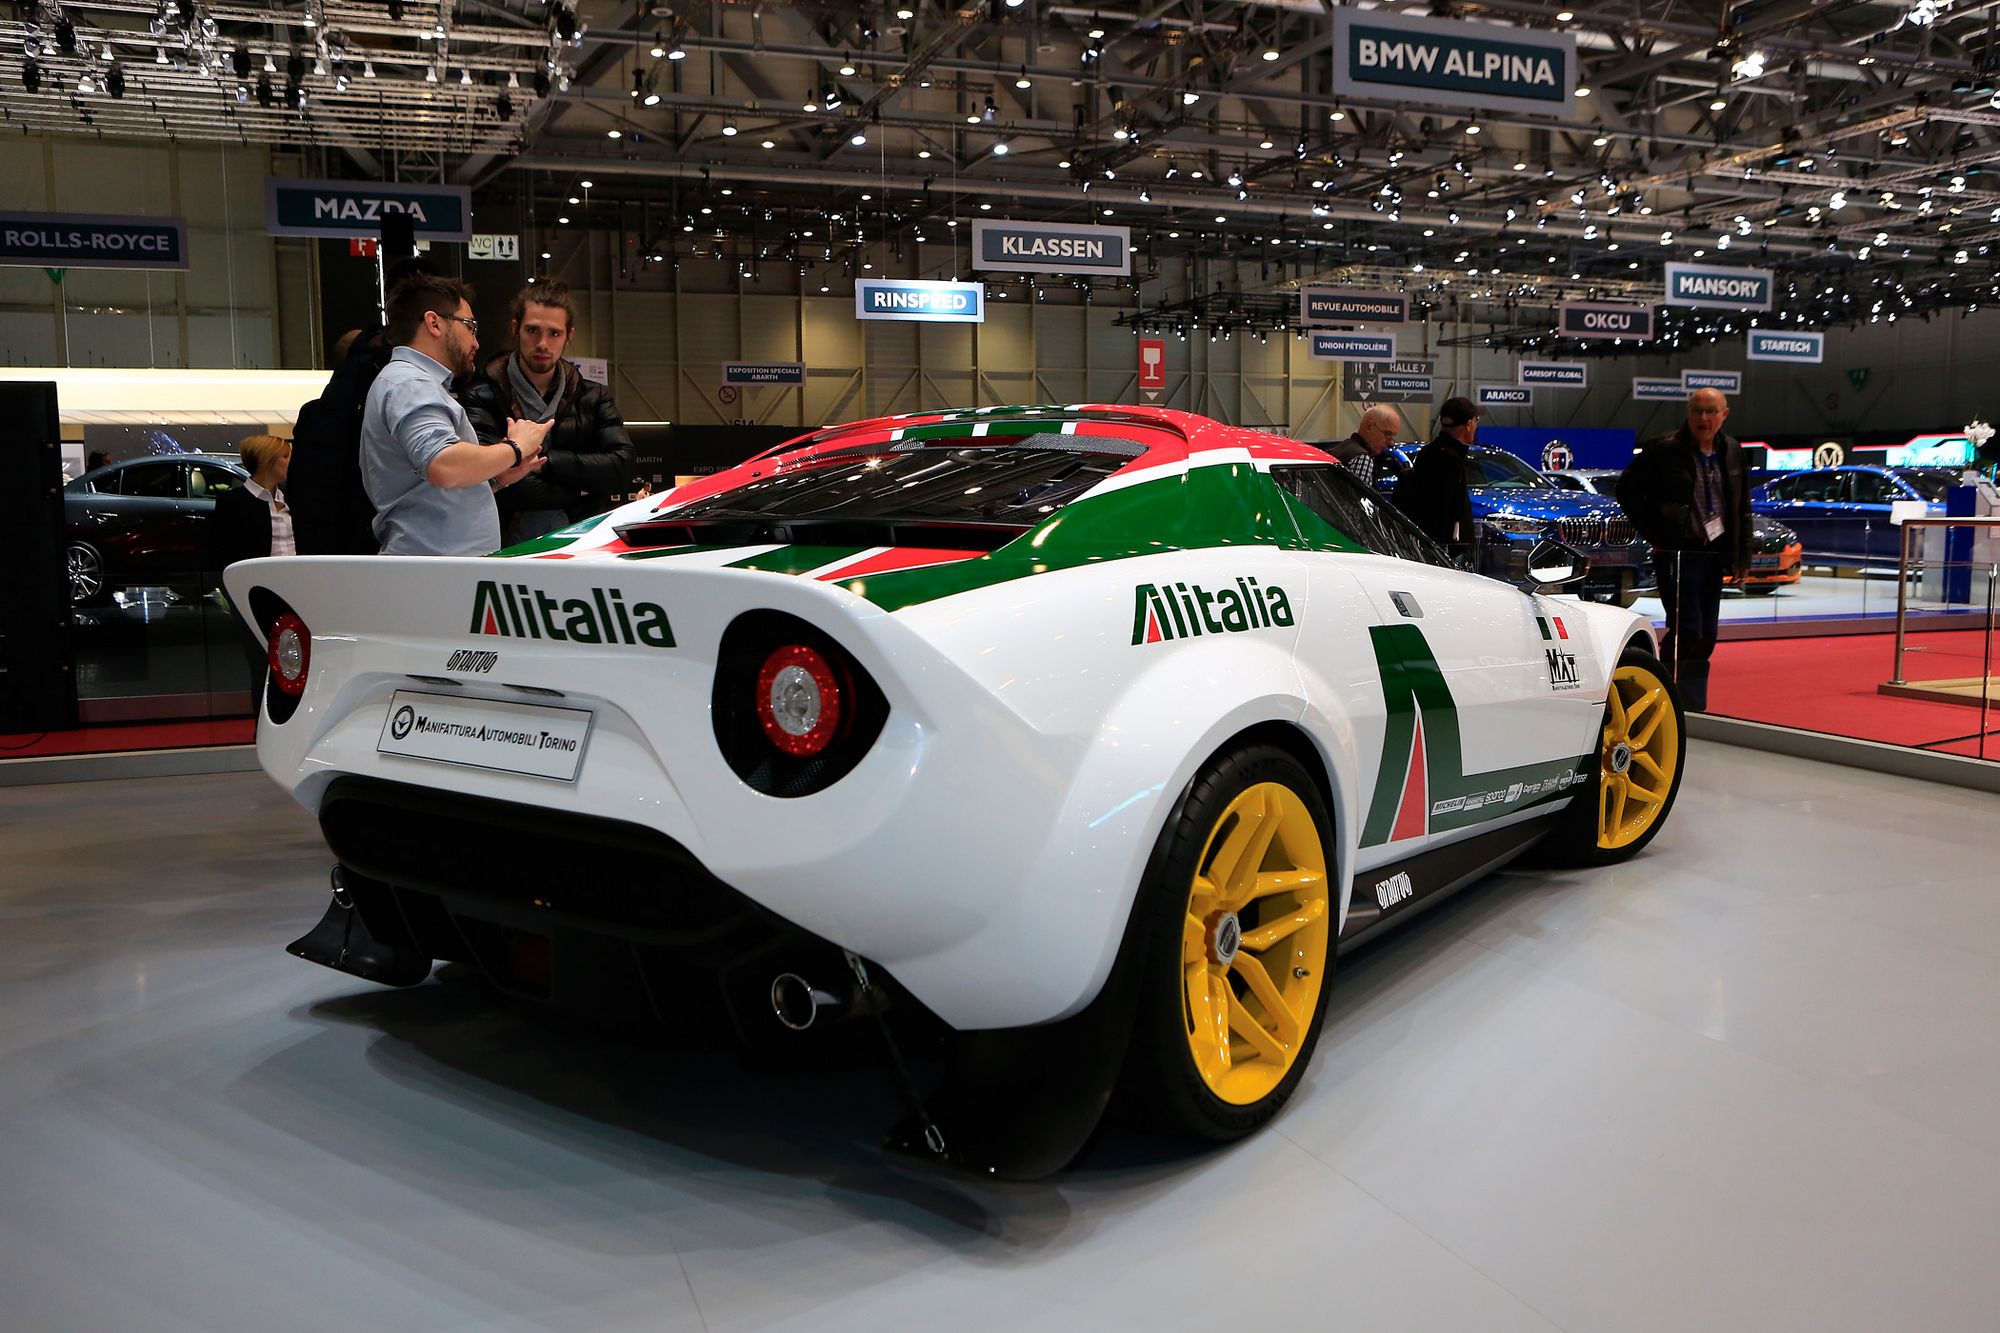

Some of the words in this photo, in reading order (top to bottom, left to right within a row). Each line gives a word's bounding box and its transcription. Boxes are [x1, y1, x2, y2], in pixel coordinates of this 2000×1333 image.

[1359, 38, 1440, 73] BMW
[1443, 48, 1555, 86] ALPINA
[5, 230, 170, 251] ROLLS-ROYCE
[471, 237, 491, 248] WC
[1002, 236, 1103, 259] KLASSEN
[1679, 276, 1761, 298] MANSORY
[874, 291, 968, 310] RINSPEED
[1311, 301, 1341, 312] REVUE
[1342, 303, 1400, 314] AUTOMOBILE
[1584, 312, 1631, 329] OKCU
[1319, 341, 1344, 350] UNION
[1760, 339, 1811, 353] STARTECH
[769, 367, 800, 375] SPECIALE
[1389, 363, 1418, 373] HALLE
[1420, 364, 1426, 373] 7
[1524, 369, 1557, 378] CARESOFT
[1557, 371, 1582, 379] GLOBAL
[1400, 380, 1429, 388] MOTORS
[1486, 391, 1525, 400] ARAMCO
[469, 580, 677, 648] Alitalia
[1131, 577, 1295, 646] Alitalia
[1433, 798, 1464, 812] MICHELIN
